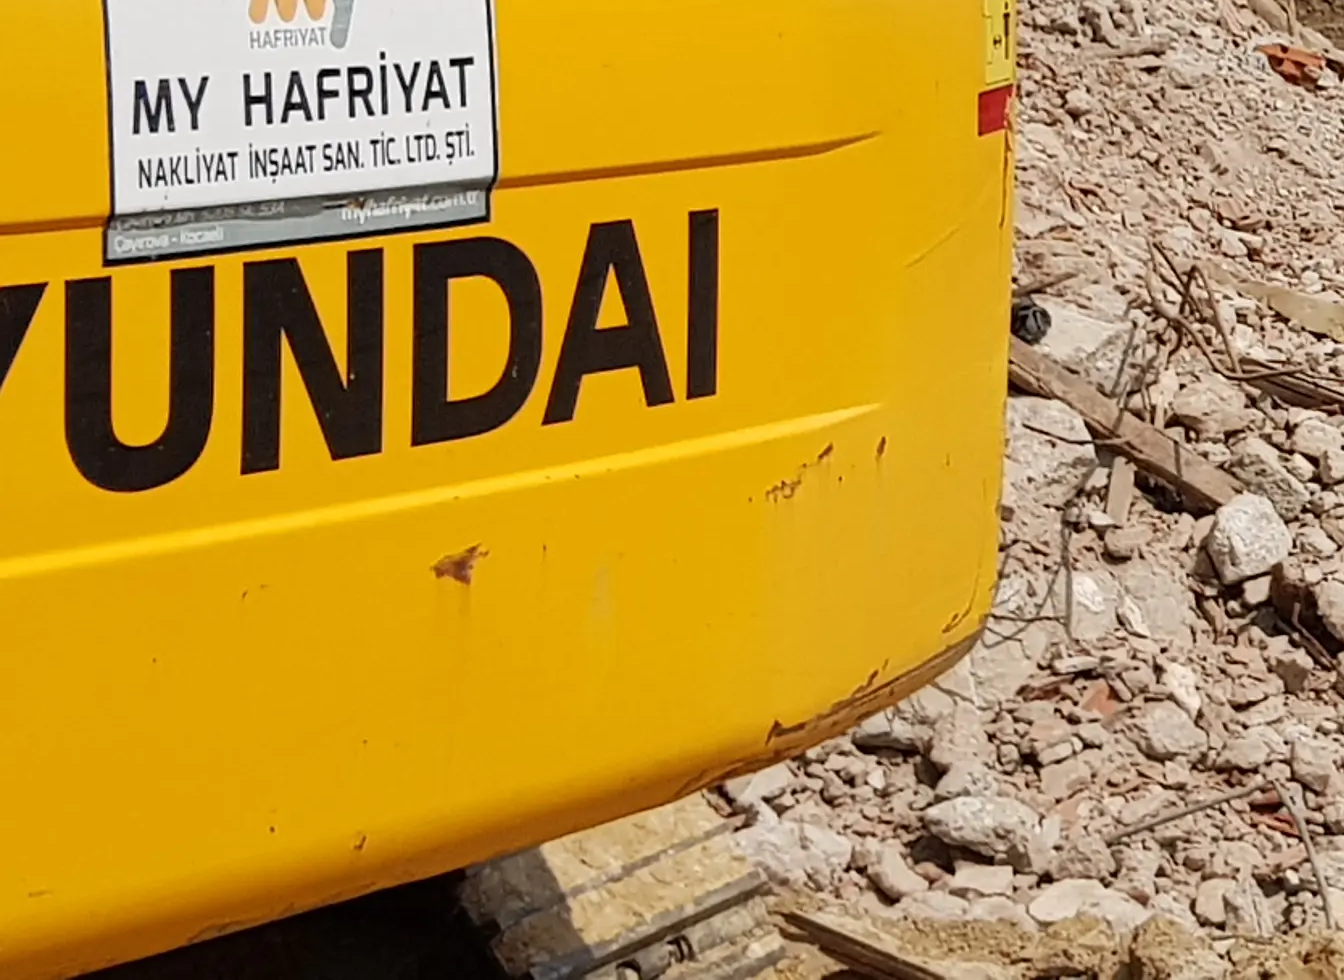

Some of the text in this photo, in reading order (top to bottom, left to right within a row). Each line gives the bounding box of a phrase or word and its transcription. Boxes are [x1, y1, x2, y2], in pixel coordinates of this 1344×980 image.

[132, 51, 475, 135] MY HAFRİYAT
[138, 123, 475, 189] NAKLİYAT İNŞAAT SAN. TİC. LTD. ŞTİ.
